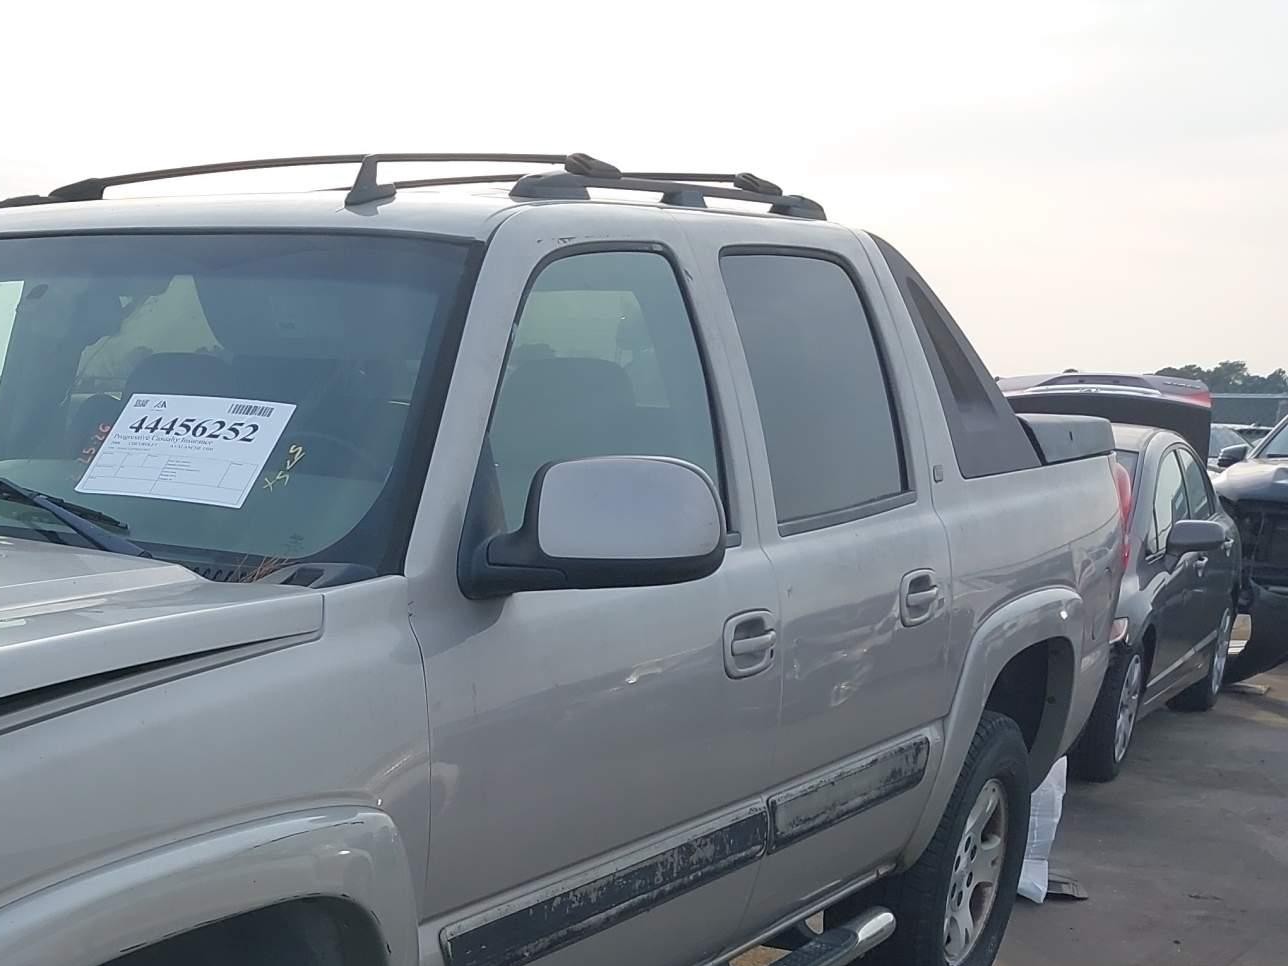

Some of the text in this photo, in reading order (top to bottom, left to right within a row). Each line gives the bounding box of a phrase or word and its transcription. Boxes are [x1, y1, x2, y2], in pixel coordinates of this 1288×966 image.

[129, 415, 259, 442] 44456252
[151, 434, 180, 444] Casualty
[181, 437, 213, 446] Insurance
